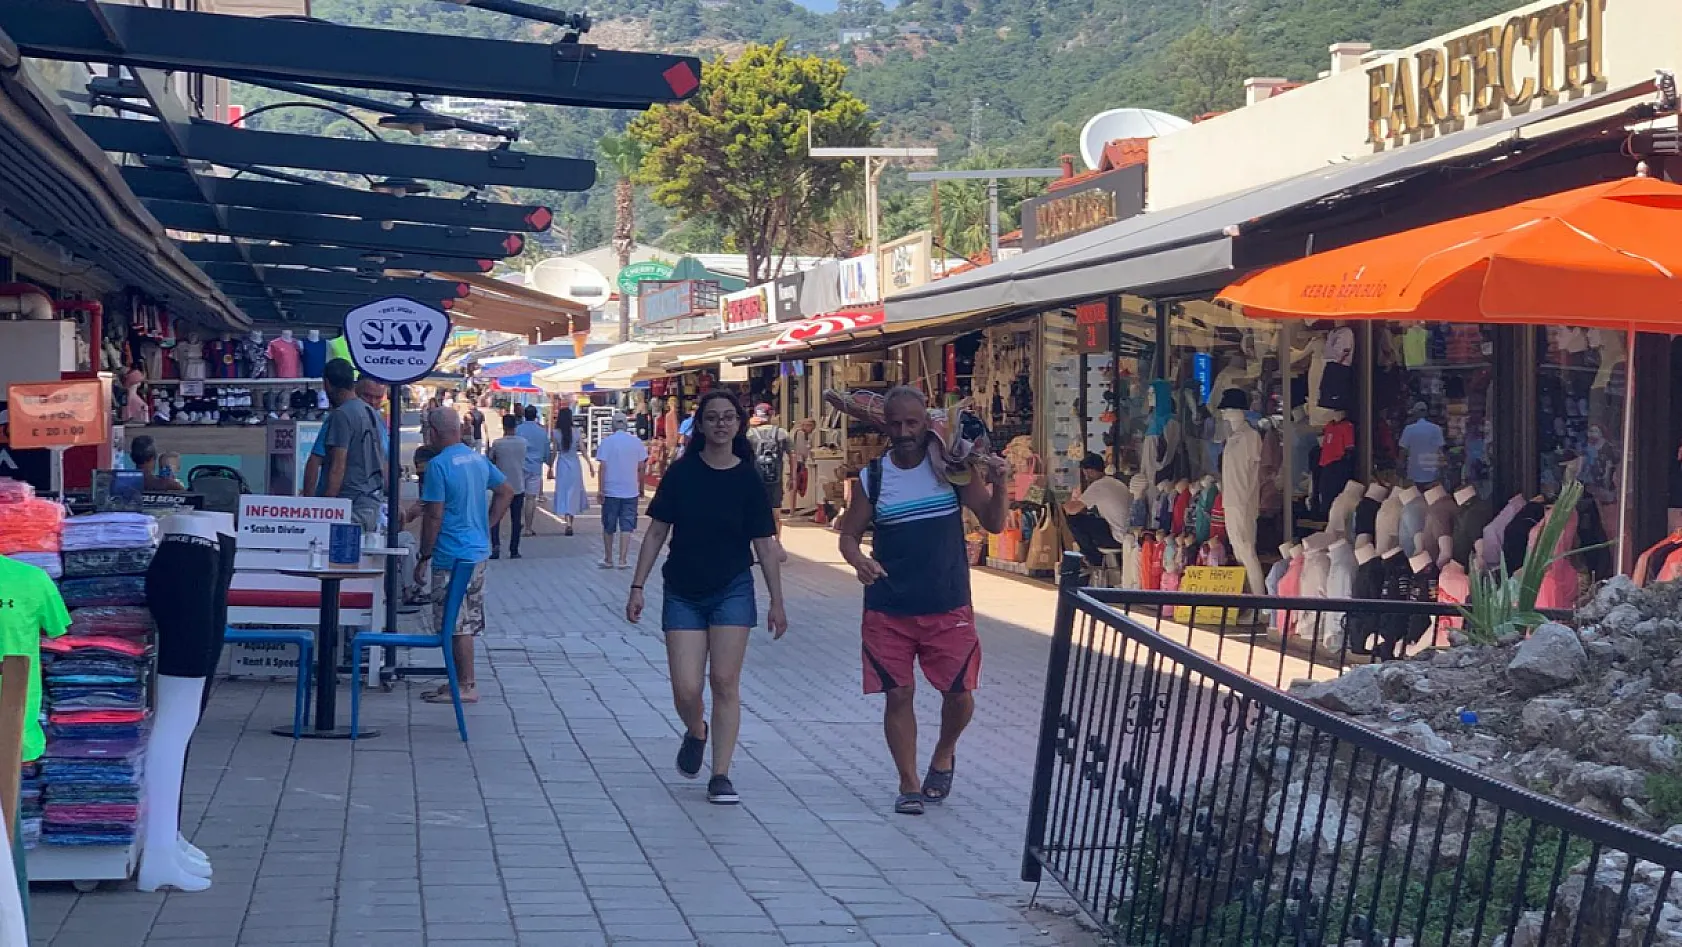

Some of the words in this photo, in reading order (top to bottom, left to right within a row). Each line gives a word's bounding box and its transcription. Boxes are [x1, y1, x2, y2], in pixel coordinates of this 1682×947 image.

[1301, 284, 1336, 298] KEBAB
[361, 319, 433, 351] SKY
[364, 356, 405, 365] Coffee
[408, 357, 427, 366] Co.
[245, 504, 345, 519] INFORMATION
[250, 525, 276, 534] Scuba
[1188, 570, 1204, 579] WE
[242, 656, 264, 666] Rent
